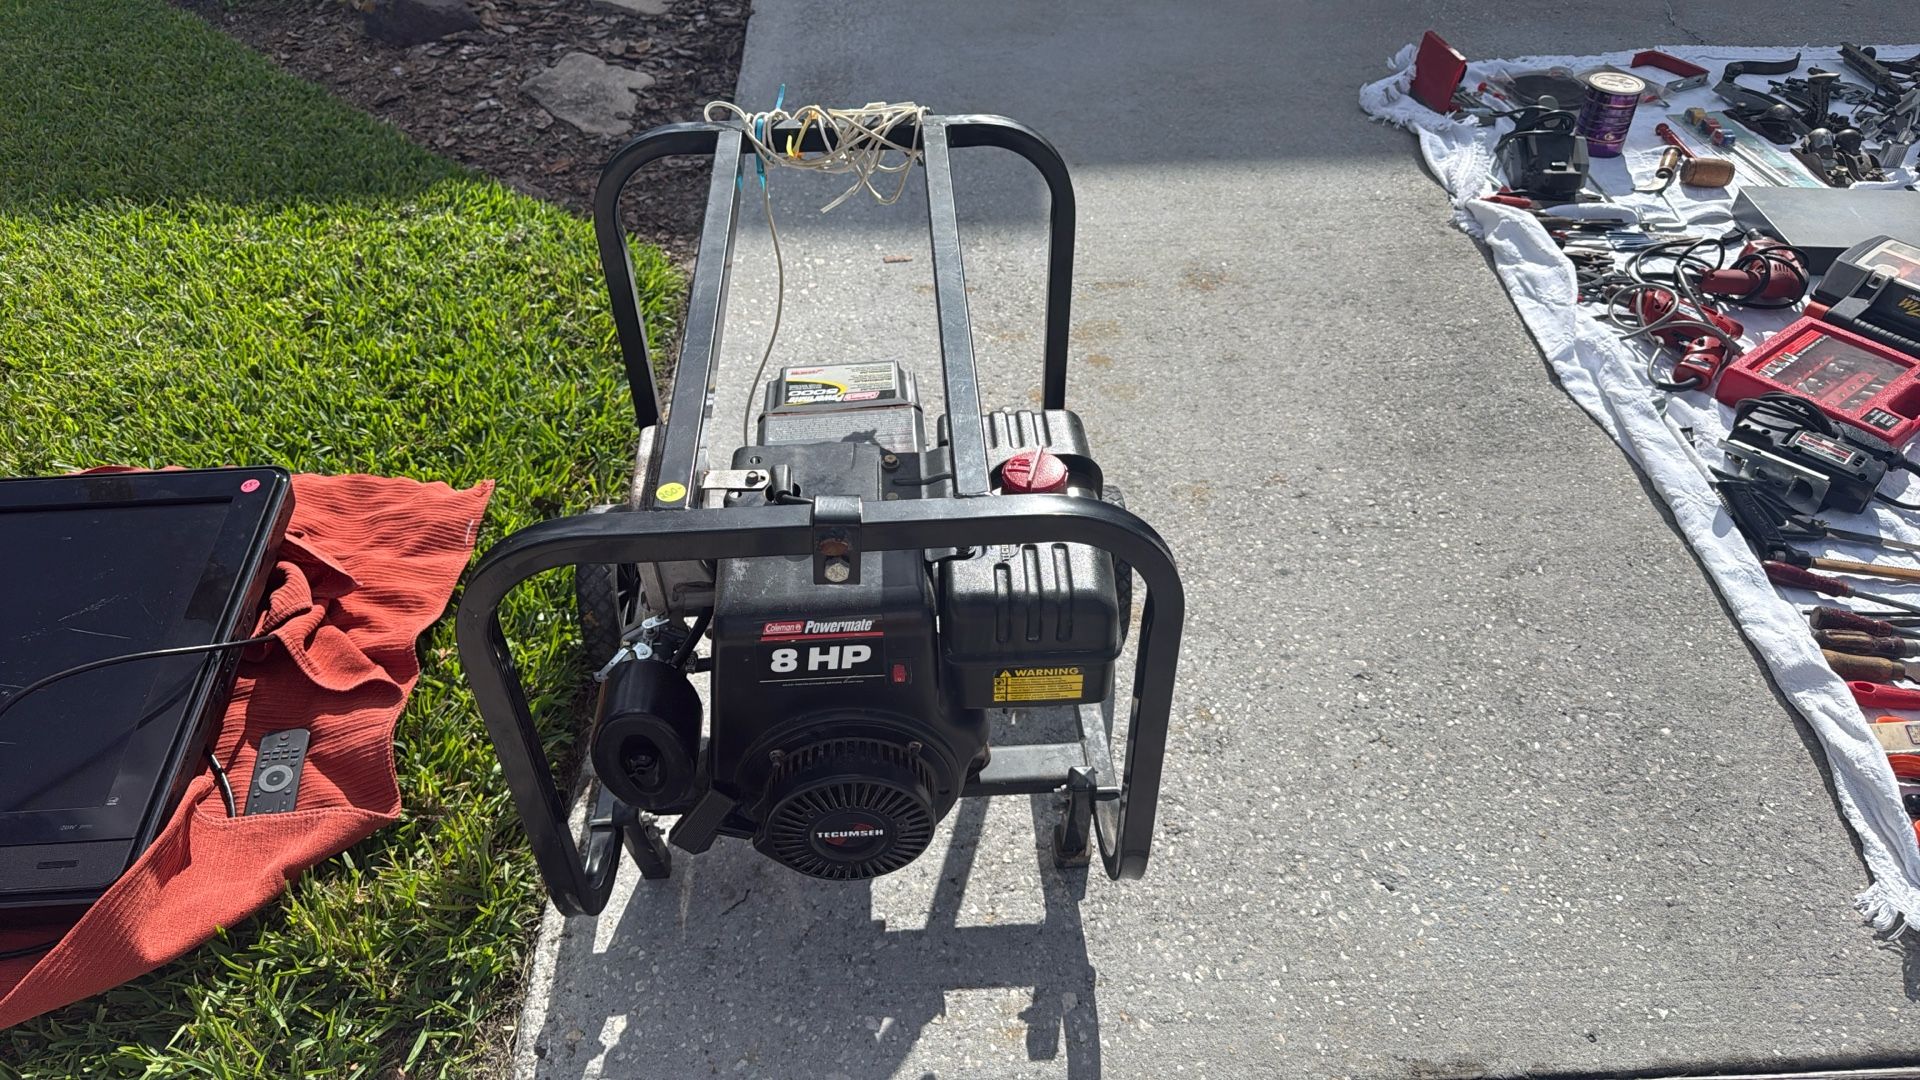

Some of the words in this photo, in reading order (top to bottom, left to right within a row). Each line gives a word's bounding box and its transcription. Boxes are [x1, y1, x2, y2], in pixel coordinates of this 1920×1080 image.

[765, 623, 795, 633] Coleman
[804, 619, 872, 634] Powermate
[770, 648, 798, 673] 8
[808, 645, 872, 671] HP
[1014, 667, 1079, 677] WARNING
[816, 829, 884, 839] TECUMSEH
